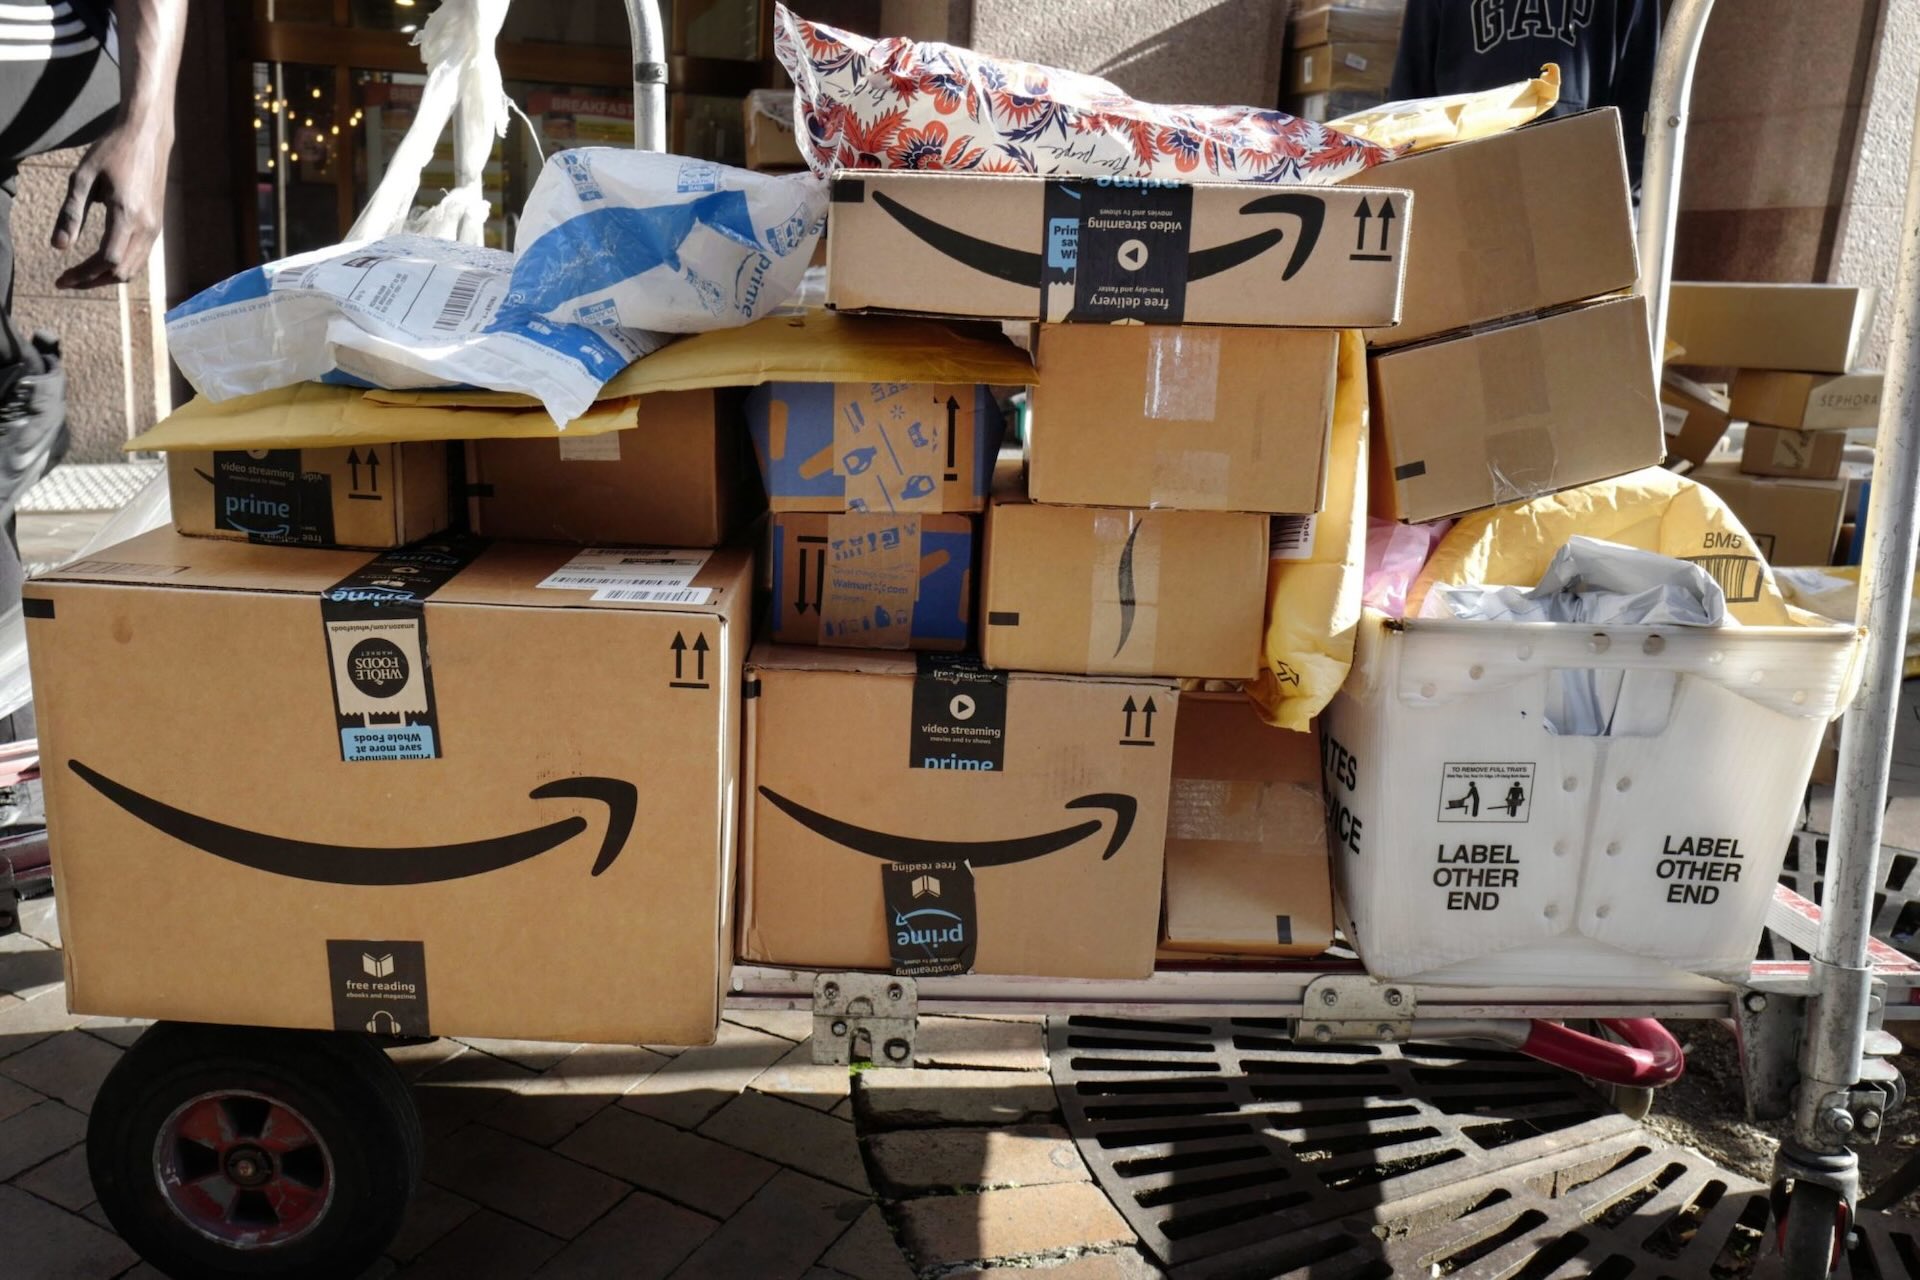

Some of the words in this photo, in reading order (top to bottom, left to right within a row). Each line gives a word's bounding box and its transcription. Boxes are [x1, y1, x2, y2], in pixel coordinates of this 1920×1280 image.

[1470, 0, 1595, 54] GAP
[1088, 217, 1147, 231] streaming
[1150, 220, 1182, 233] video
[741, 253, 773, 319] prime
[1089, 294, 1141, 309] delivery
[1144, 298, 1170, 310] free
[1819, 393, 1879, 408] SEPHORA
[221, 462, 246, 473] video
[247, 466, 295, 480] streaming
[225, 493, 290, 518] prime
[1703, 532, 1743, 549] BM5
[832, 578, 872, 592] Walmart
[355, 657, 400, 670] FOODS
[356, 669, 403, 681] WHOLE
[388, 733, 422, 743] Whole
[921, 723, 949, 734] video
[951, 727, 1001, 738] streaming
[353, 734, 385, 744] Foods
[355, 745, 367, 754] at
[369, 744, 396, 753] more
[399, 744, 422, 752] save
[1437, 844, 1520, 864] LABEL
[1663, 835, 1744, 859] LABEL
[891, 862, 932, 872] reading
[935, 861, 957, 871] free
[1656, 859, 1742, 882] OTHER
[1433, 867, 1519, 888] OTHER
[1447, 891, 1500, 911] END
[1666, 884, 1720, 905] END
[897, 923, 964, 948] prime
[346, 980, 370, 990] free
[372, 981, 416, 993] reading
